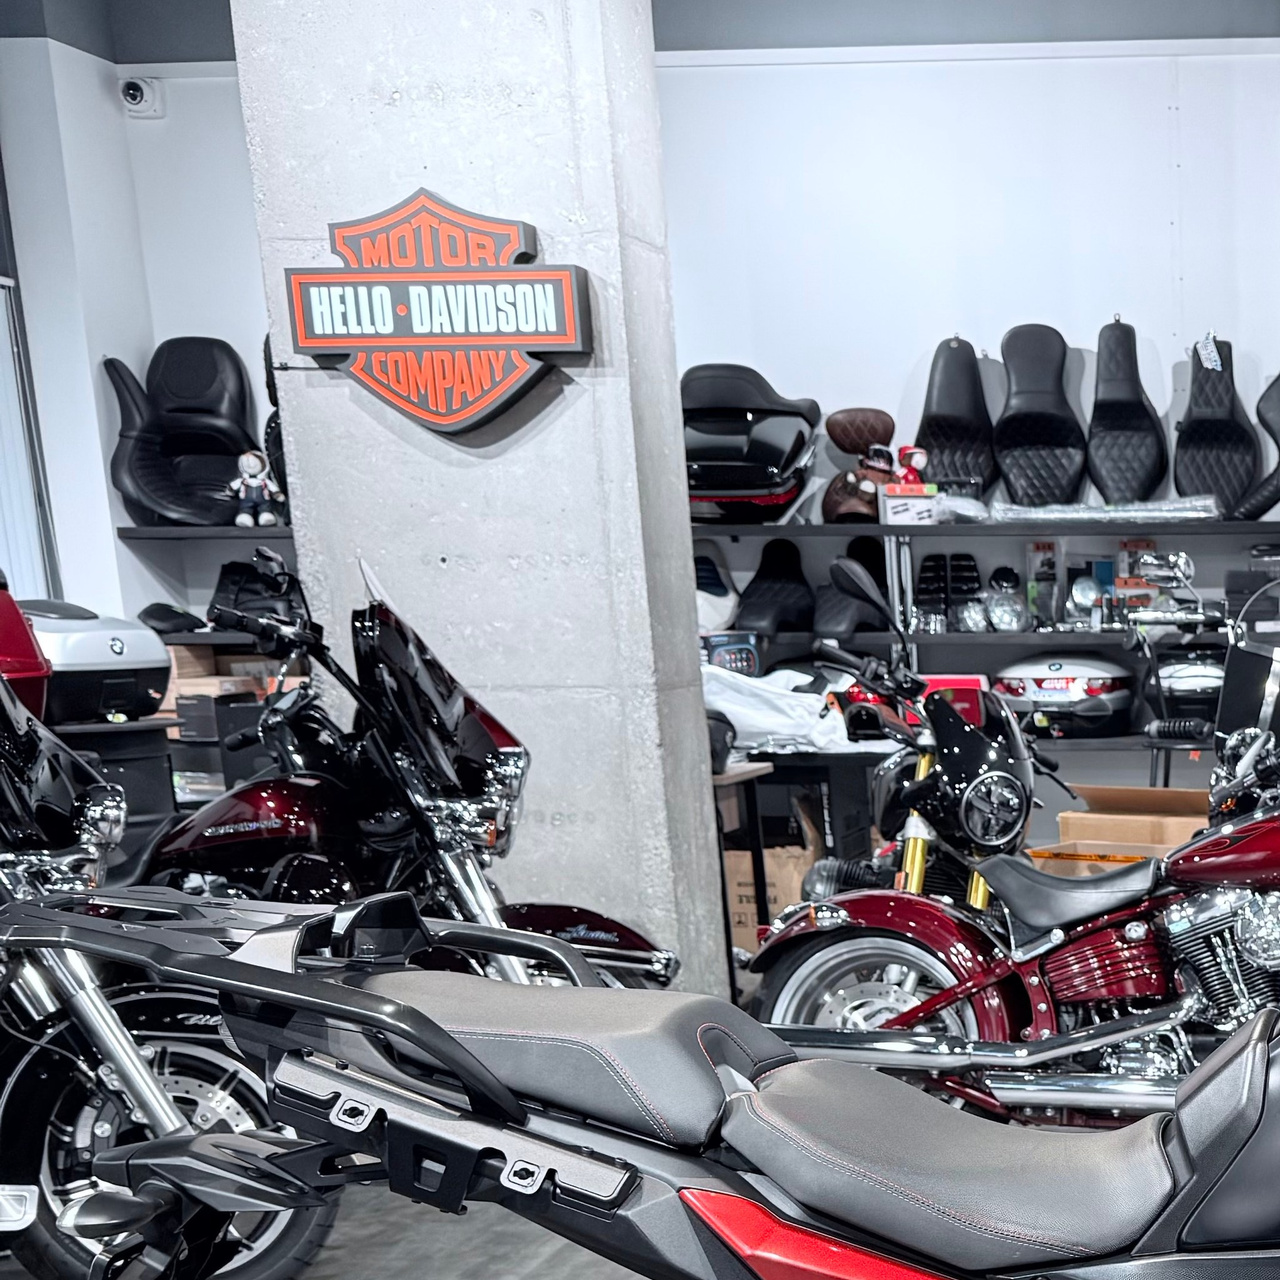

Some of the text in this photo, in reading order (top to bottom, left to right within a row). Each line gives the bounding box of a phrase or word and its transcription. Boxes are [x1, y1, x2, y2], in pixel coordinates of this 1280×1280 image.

[360, 211, 497, 268] MOTOR
[309, 283, 558, 335] HELLO DAVIDSON
[371, 350, 507, 413] COMPANY
